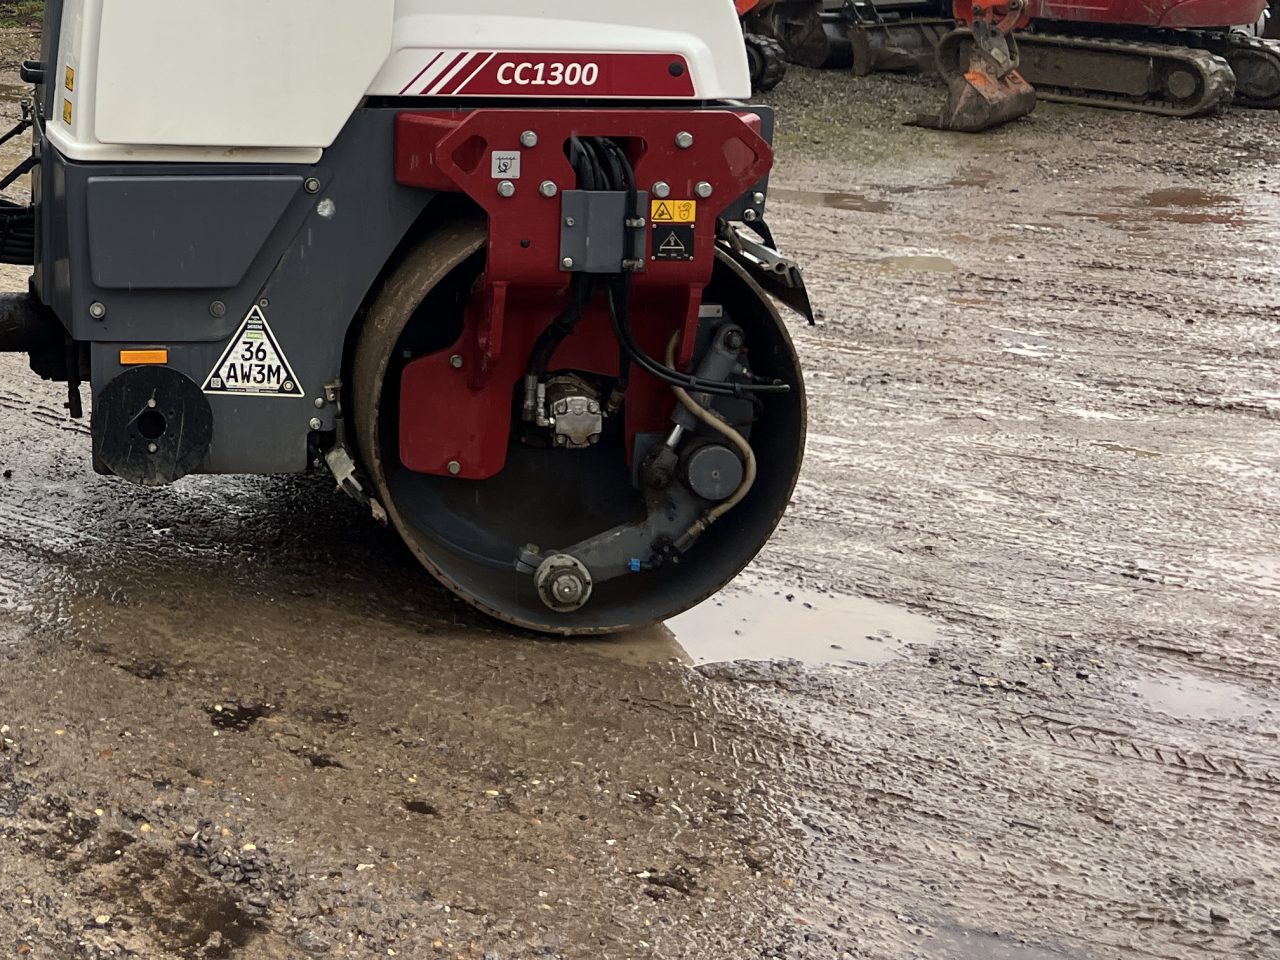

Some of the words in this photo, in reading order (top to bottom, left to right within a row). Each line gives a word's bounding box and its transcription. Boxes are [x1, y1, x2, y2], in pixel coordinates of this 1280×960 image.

[496, 62, 599, 86] CC1300
[241, 341, 267, 361] 36
[226, 363, 281, 384] AW3M
